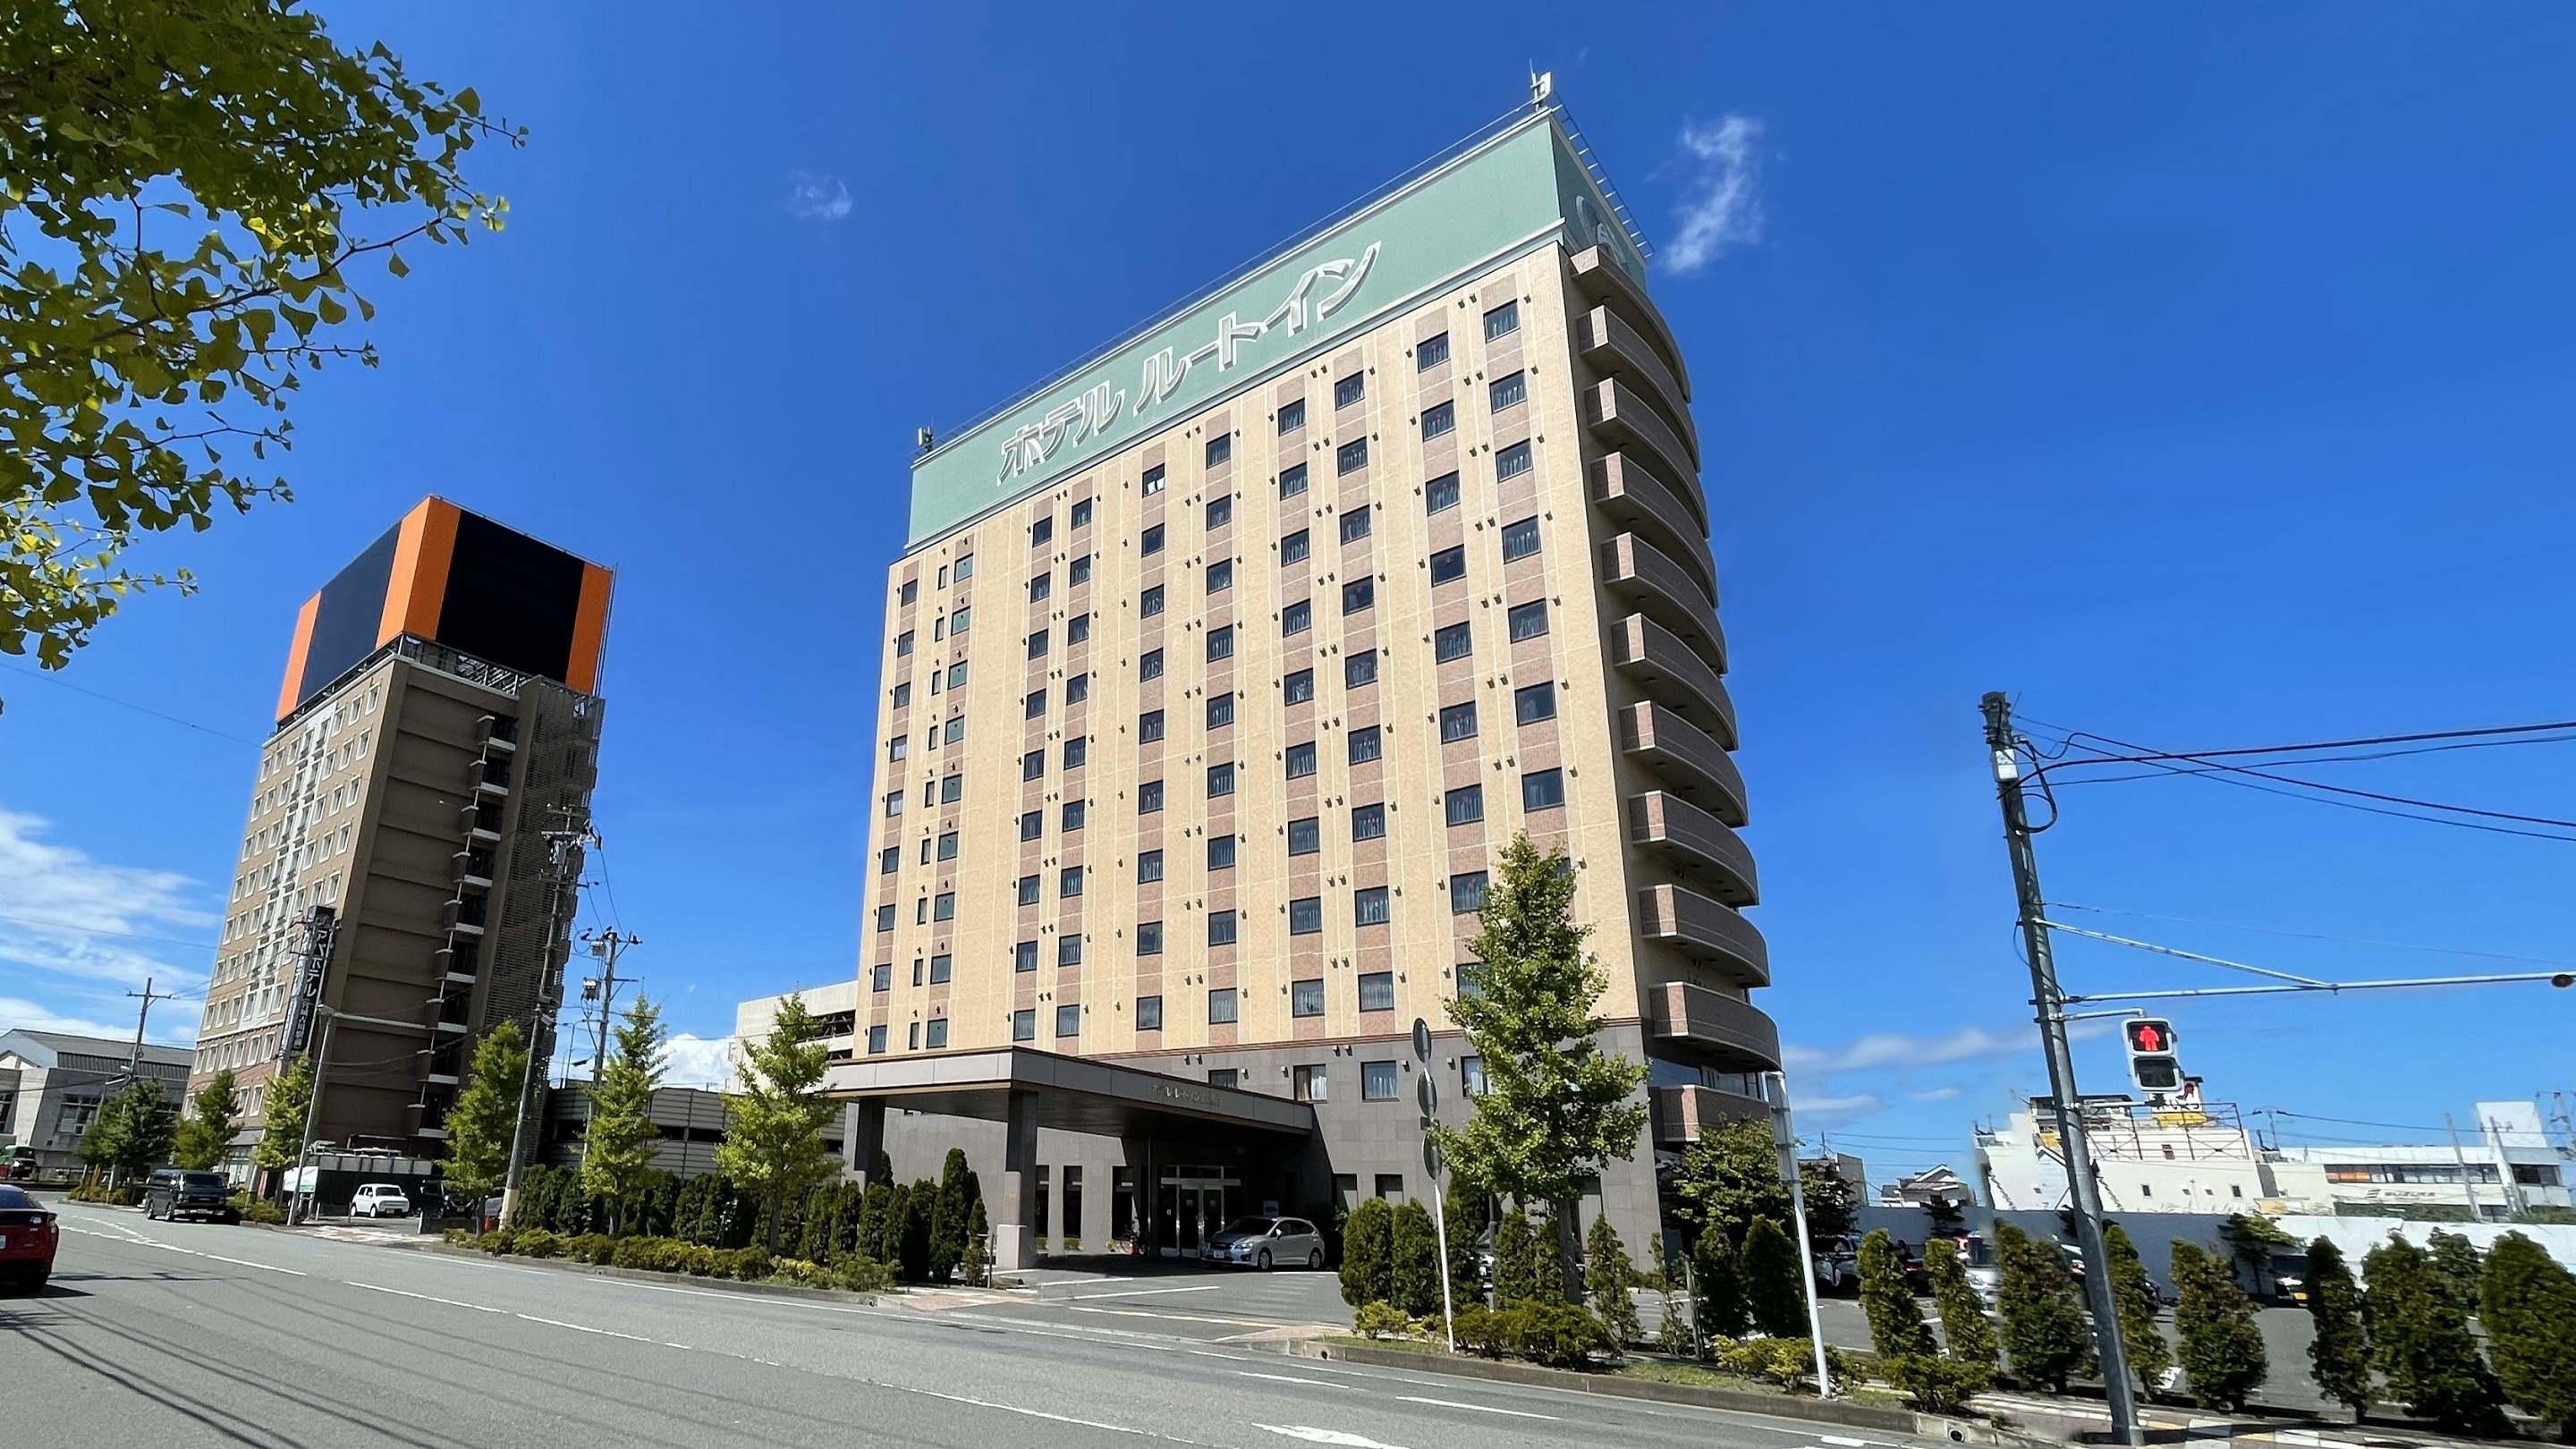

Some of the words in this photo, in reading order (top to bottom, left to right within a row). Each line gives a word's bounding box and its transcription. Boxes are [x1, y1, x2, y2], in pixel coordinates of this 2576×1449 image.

[996, 379, 1125, 487] ホテル
[1132, 240, 1382, 418] ルートイン
[303, 929, 328, 997] アパホテル
